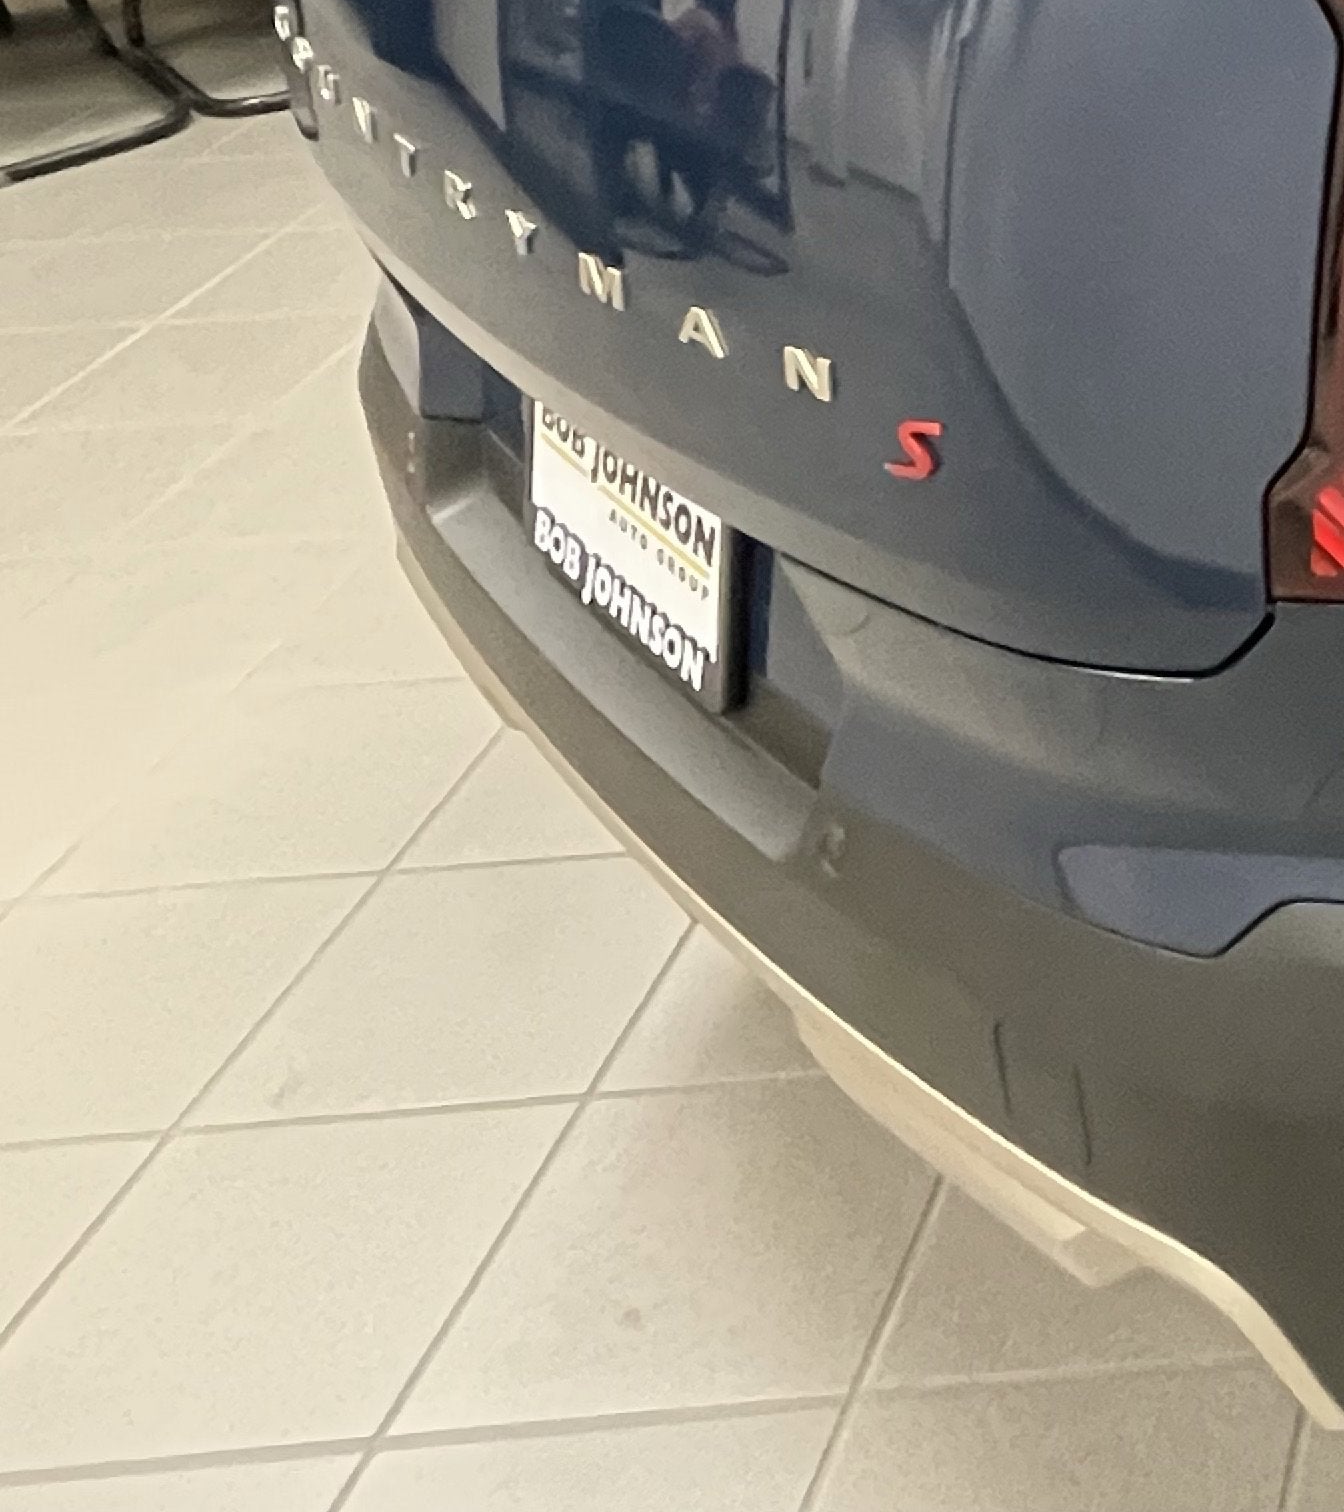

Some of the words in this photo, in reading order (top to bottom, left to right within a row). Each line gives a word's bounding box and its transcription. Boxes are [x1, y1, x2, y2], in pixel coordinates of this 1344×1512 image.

[590, 441, 717, 567] JOHNSON
[884, 419, 944, 480] S
[534, 507, 584, 580] BOB
[580, 553, 707, 692] JOHNSON
[609, 508, 648, 550] AUTO
[656, 548, 710, 600] GROUP
